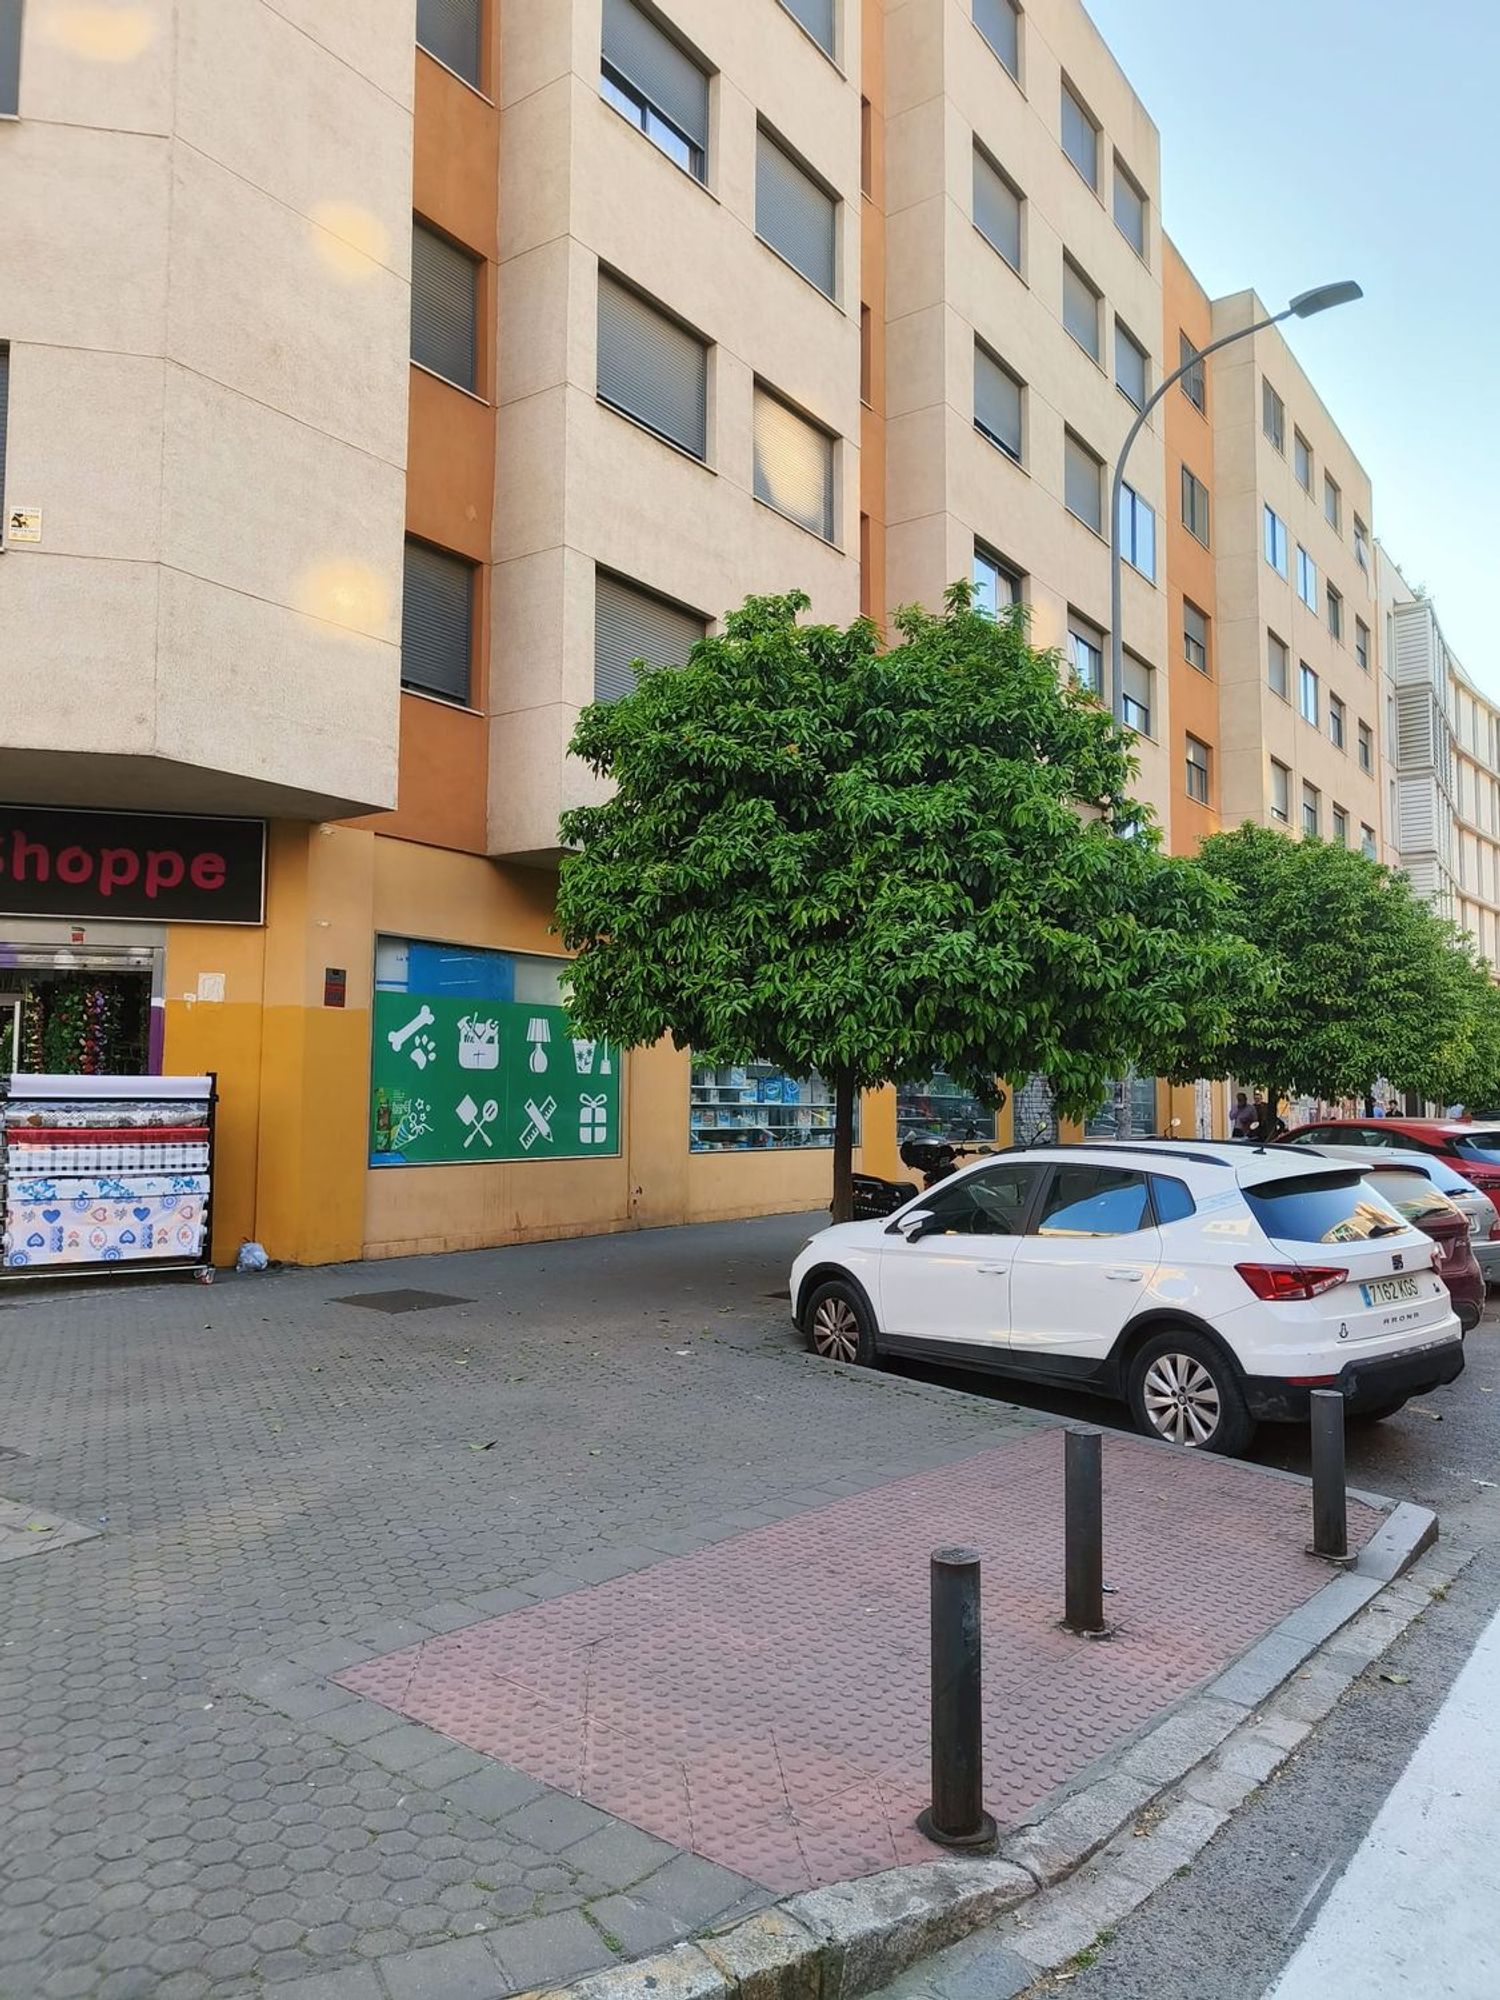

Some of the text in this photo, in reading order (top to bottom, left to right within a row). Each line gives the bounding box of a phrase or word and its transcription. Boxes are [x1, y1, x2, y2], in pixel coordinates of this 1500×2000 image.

[0, 830, 227, 898] hoppe
[1369, 1278, 1418, 1303] 7162 KGS
